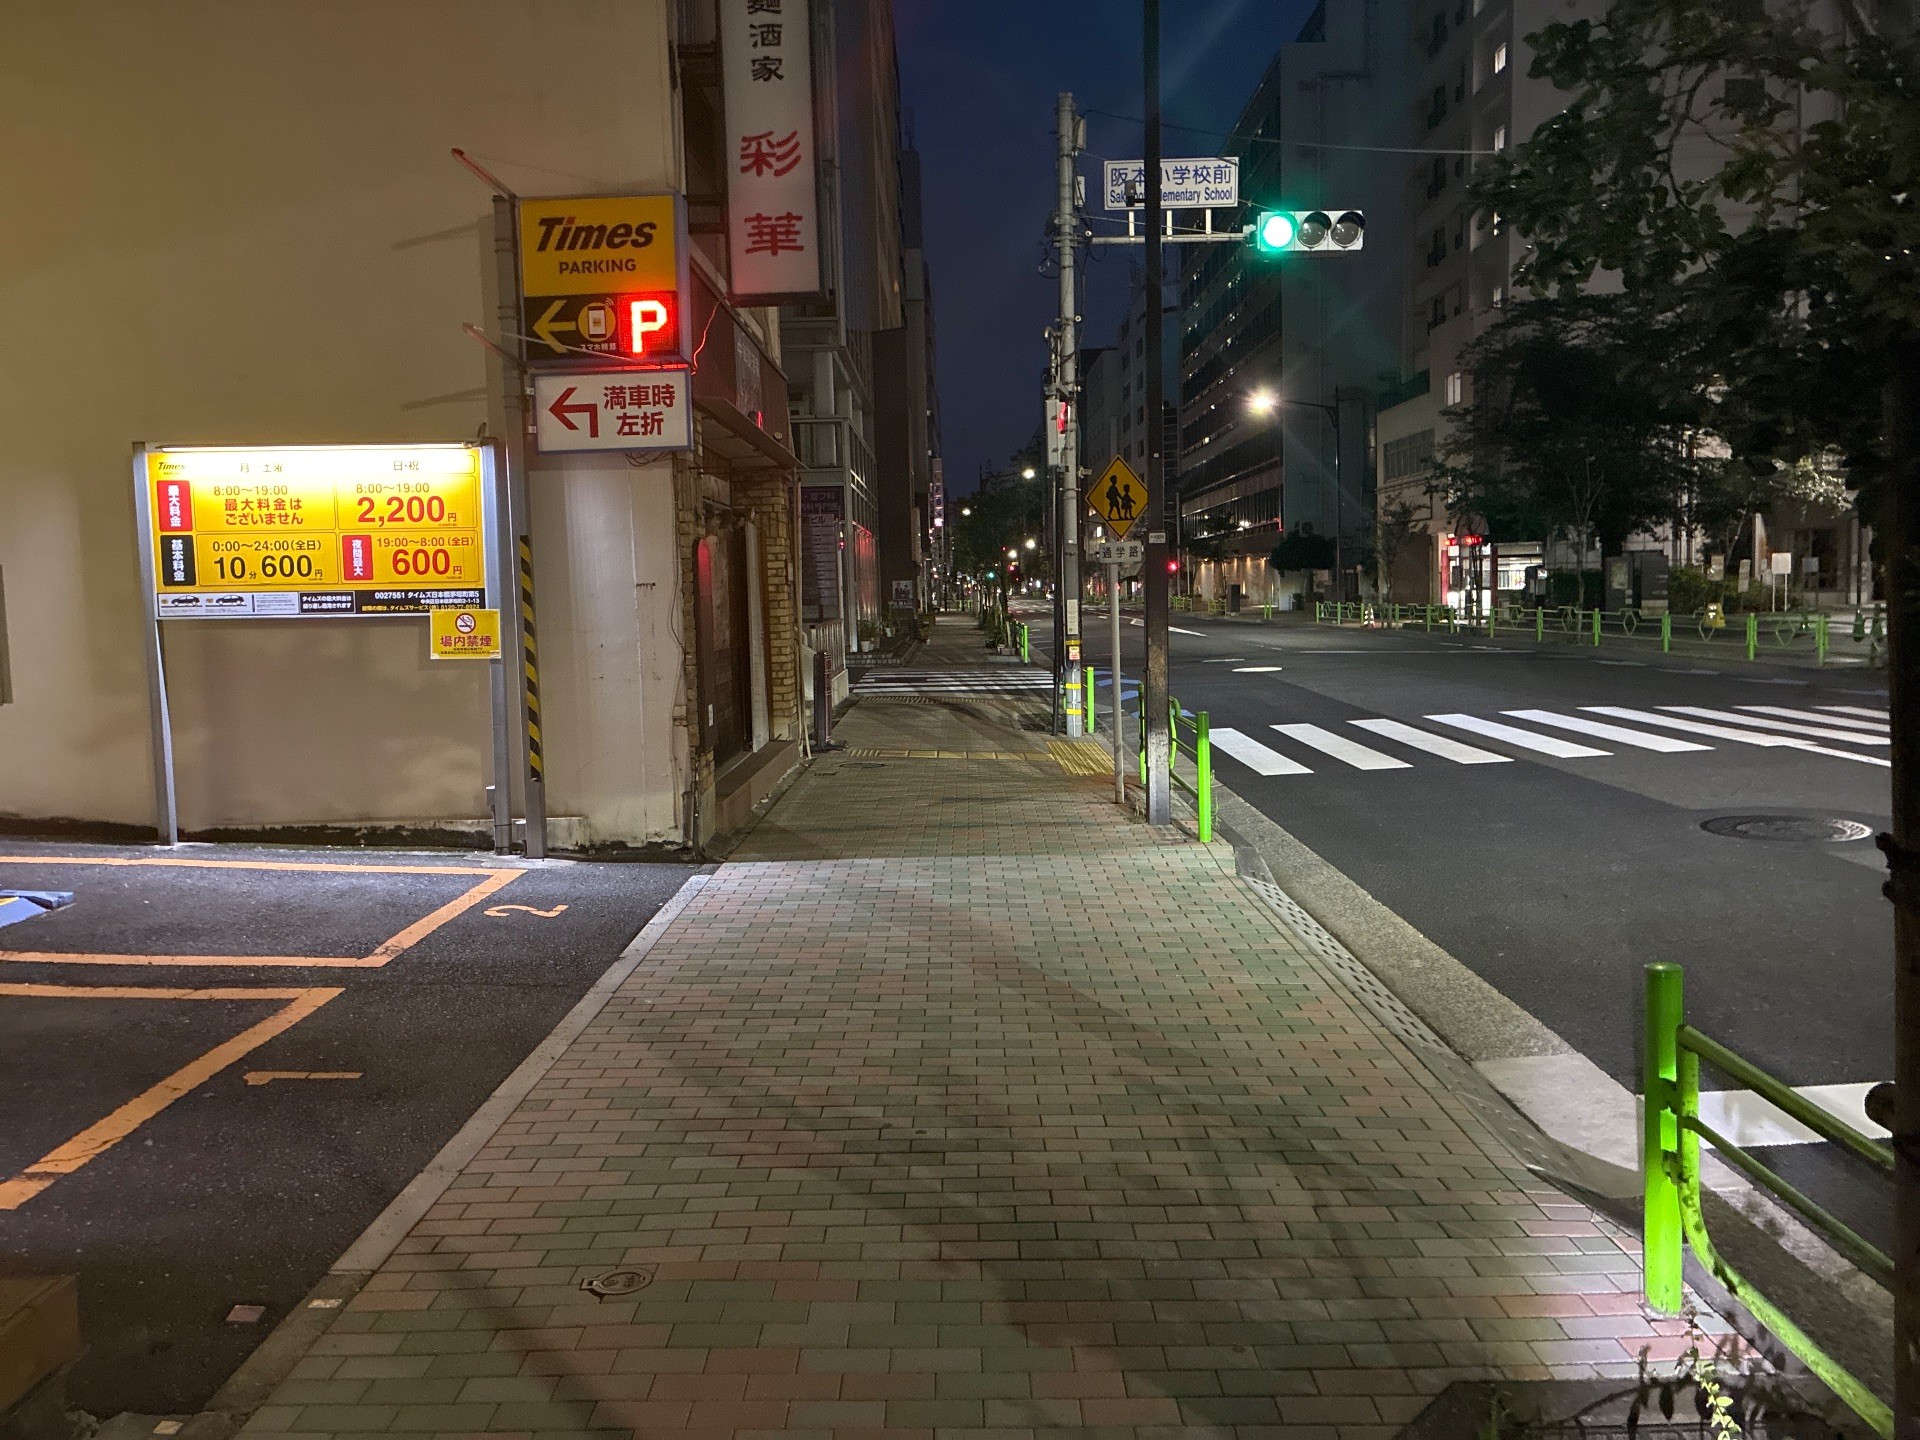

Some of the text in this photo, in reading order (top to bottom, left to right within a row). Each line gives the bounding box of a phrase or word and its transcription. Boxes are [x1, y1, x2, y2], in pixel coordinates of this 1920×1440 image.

[740, 131, 804, 256] 彩華
[1160, 189, 1201, 204] lementary
[1204, 187, 1232, 201] School
[537, 216, 657, 252] Times
[559, 258, 637, 275] PARKING
[630, 300, 668, 353] P
[603, 383, 676, 411] 満車時
[616, 412, 664, 436] 左折
[158, 461, 186, 471] Times
[213, 485, 288, 496] 8:00～19:00
[356, 483, 430, 494] 8:00～19:00
[225, 498, 303, 511] 最大料金は
[225, 512, 304, 526] ございません
[1102, 546, 1138, 559] 通学路
[171, 539, 185, 582] 基本料金
[374, 591, 405, 599] 0027551
[440, 635, 492, 647] 場内禁煙
